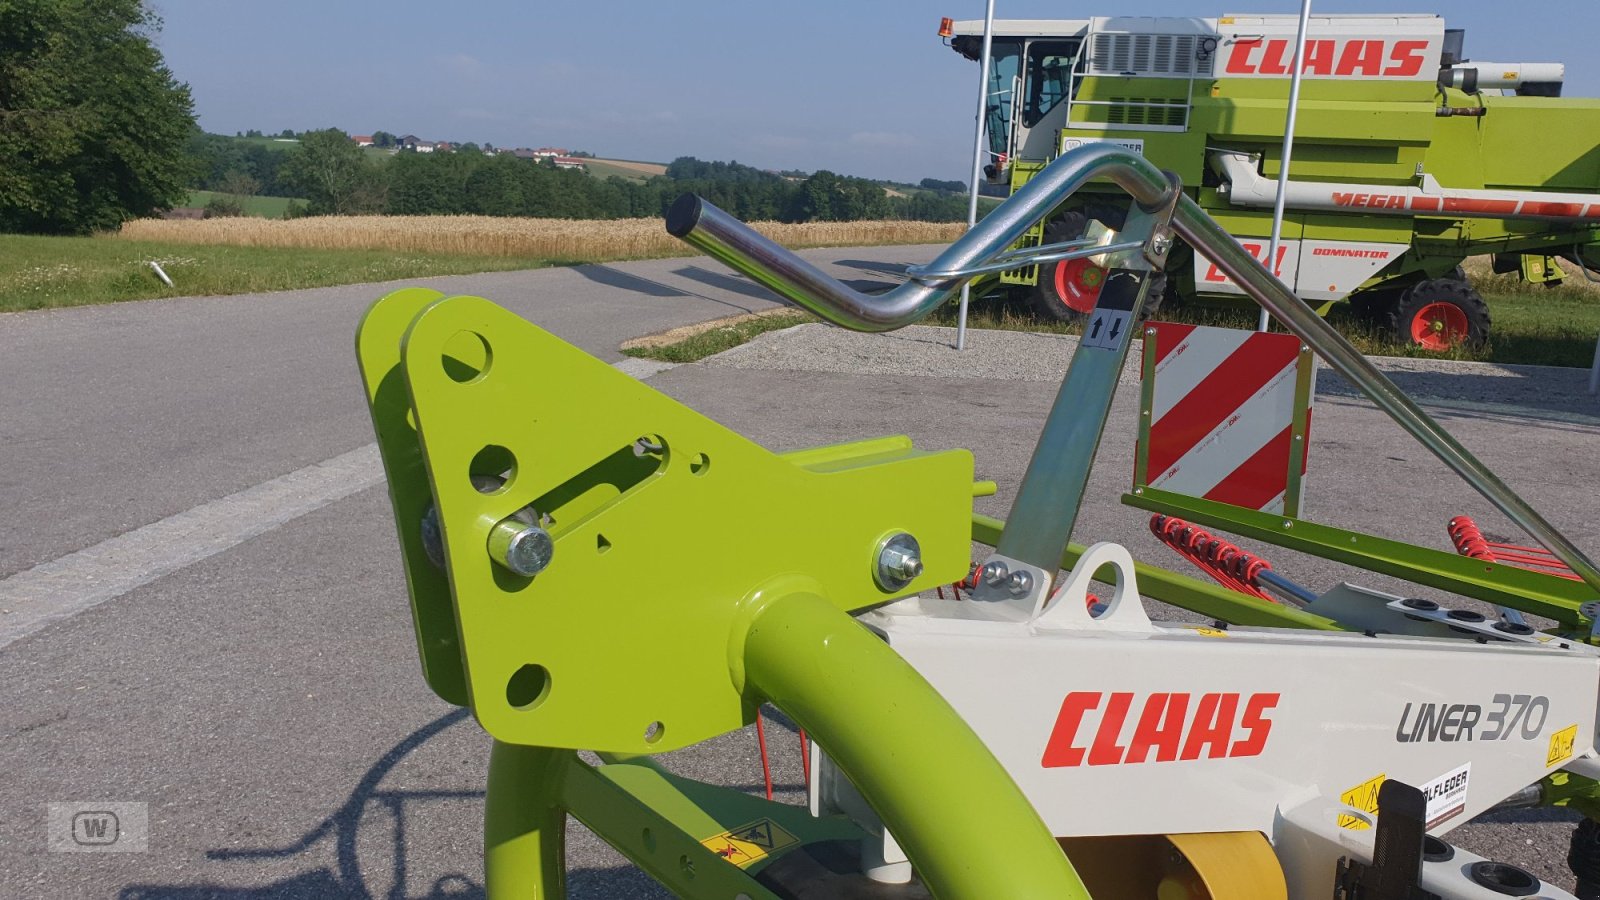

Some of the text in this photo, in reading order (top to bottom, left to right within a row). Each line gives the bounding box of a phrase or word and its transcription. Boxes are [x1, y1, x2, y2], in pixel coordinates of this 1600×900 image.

[1226, 39, 1429, 76] CLAAS
[1332, 192, 1406, 209] MEGA
[1312, 248, 1389, 259] DOMINATOR
[1041, 691, 1281, 768] CLAAS
[1396, 693, 1550, 742] LINER 370
[1423, 770, 1467, 801] ÖLFLEDER
